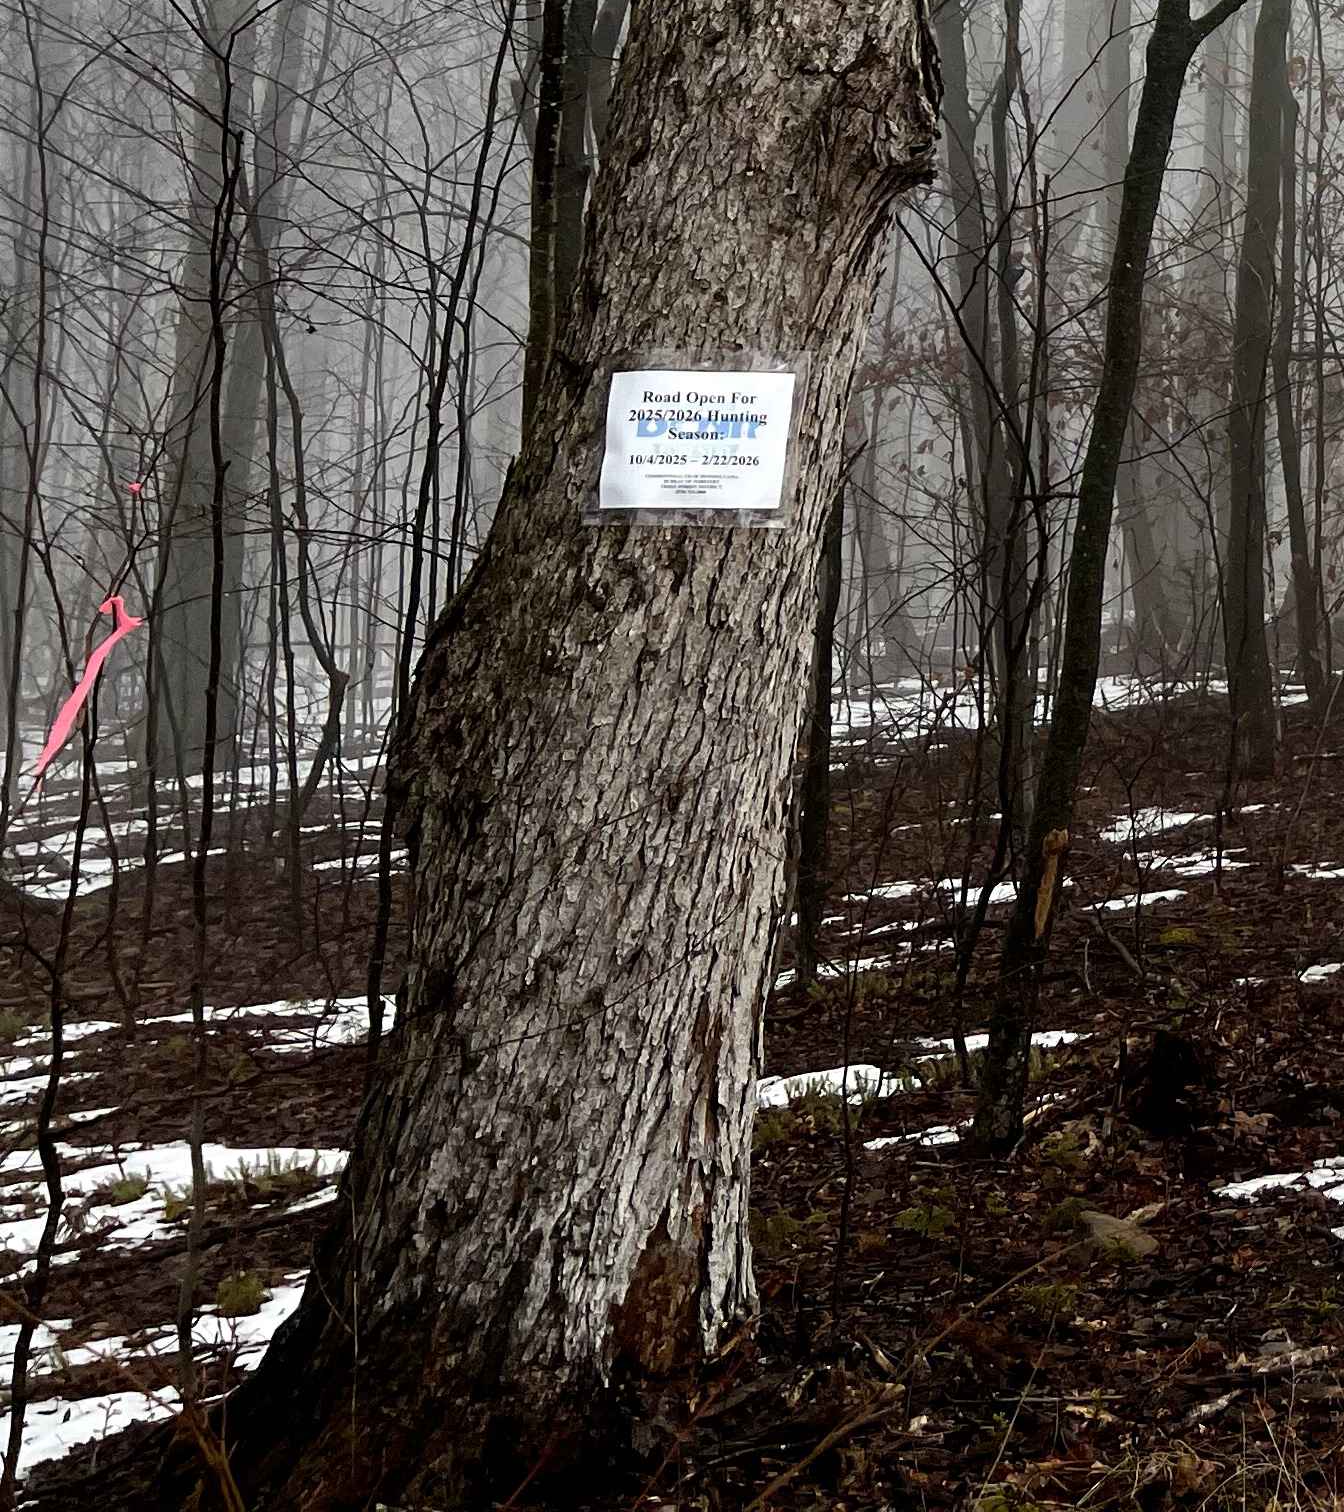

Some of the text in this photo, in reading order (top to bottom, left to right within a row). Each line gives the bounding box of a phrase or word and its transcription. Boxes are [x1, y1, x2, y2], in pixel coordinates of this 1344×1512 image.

[642, 390, 757, 406] Road Open For
[628, 409, 768, 425] 2025/2026 Hunting
[667, 427, 725, 441] Season:
[629, 454, 688, 466] 10/4/2025
[701, 455, 760, 467] 2/22/2026
